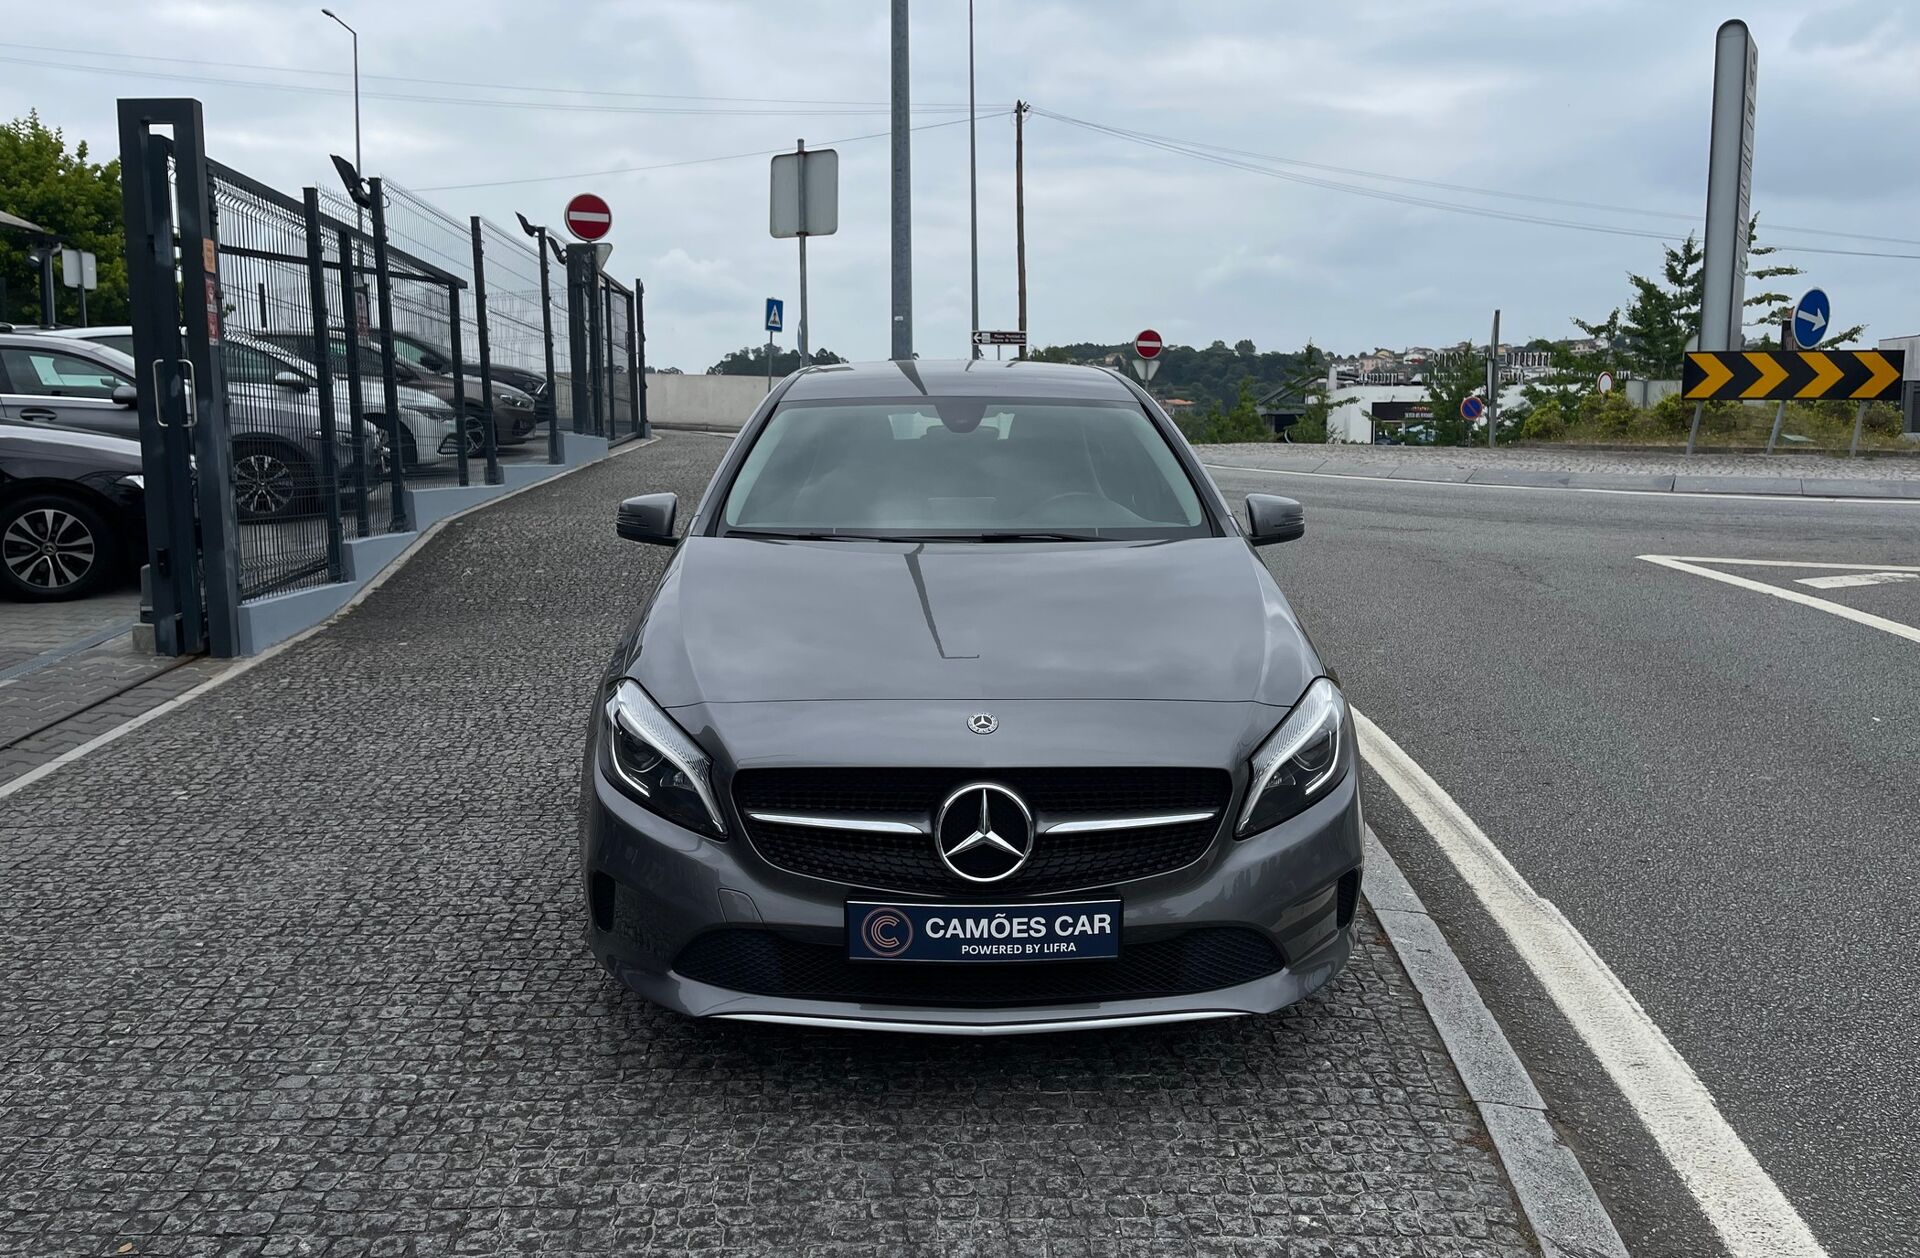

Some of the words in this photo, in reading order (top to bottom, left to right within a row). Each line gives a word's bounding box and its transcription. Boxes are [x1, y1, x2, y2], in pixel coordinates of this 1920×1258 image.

[925, 913, 1045, 938] CAMÕES
[1054, 913, 1111, 937] CAR
[961, 944, 1022, 955] POWERED
[1025, 943, 1041, 954] BY
[1044, 942, 1077, 953] LIFRA
